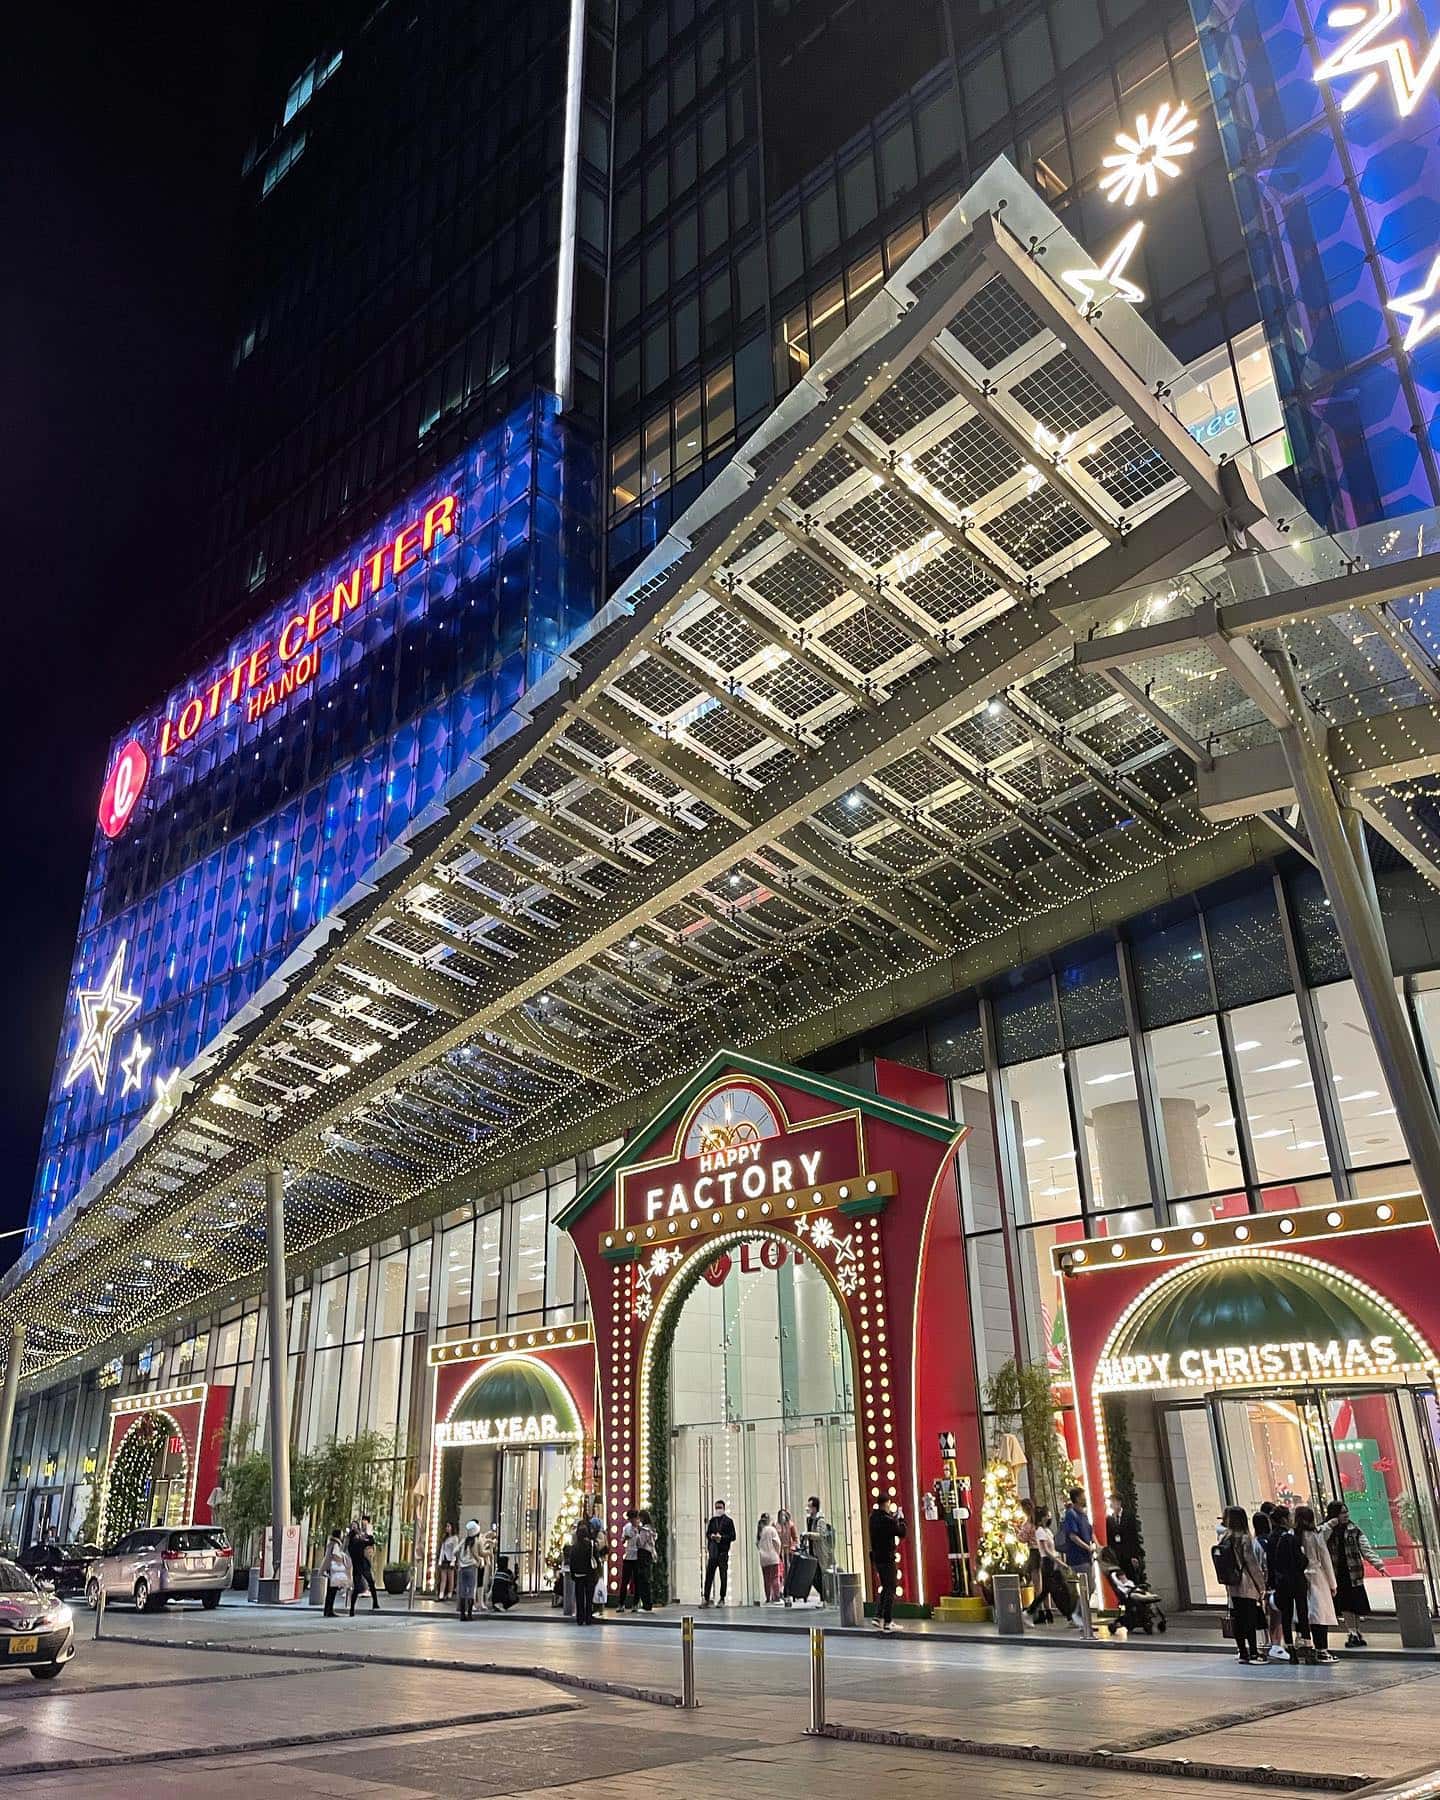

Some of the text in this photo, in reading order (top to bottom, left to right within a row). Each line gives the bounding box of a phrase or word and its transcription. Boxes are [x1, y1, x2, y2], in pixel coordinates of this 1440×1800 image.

[160, 495, 458, 758] LOTTE CENTER
[248, 646, 321, 723] HANOI
[646, 1150, 822, 1221] FACTORY
[700, 1142, 762, 1174] HAPPY
[1099, 1335, 1398, 1384] HAPPY CHRISTMAS
[494, 1414, 558, 1442] YEAR
